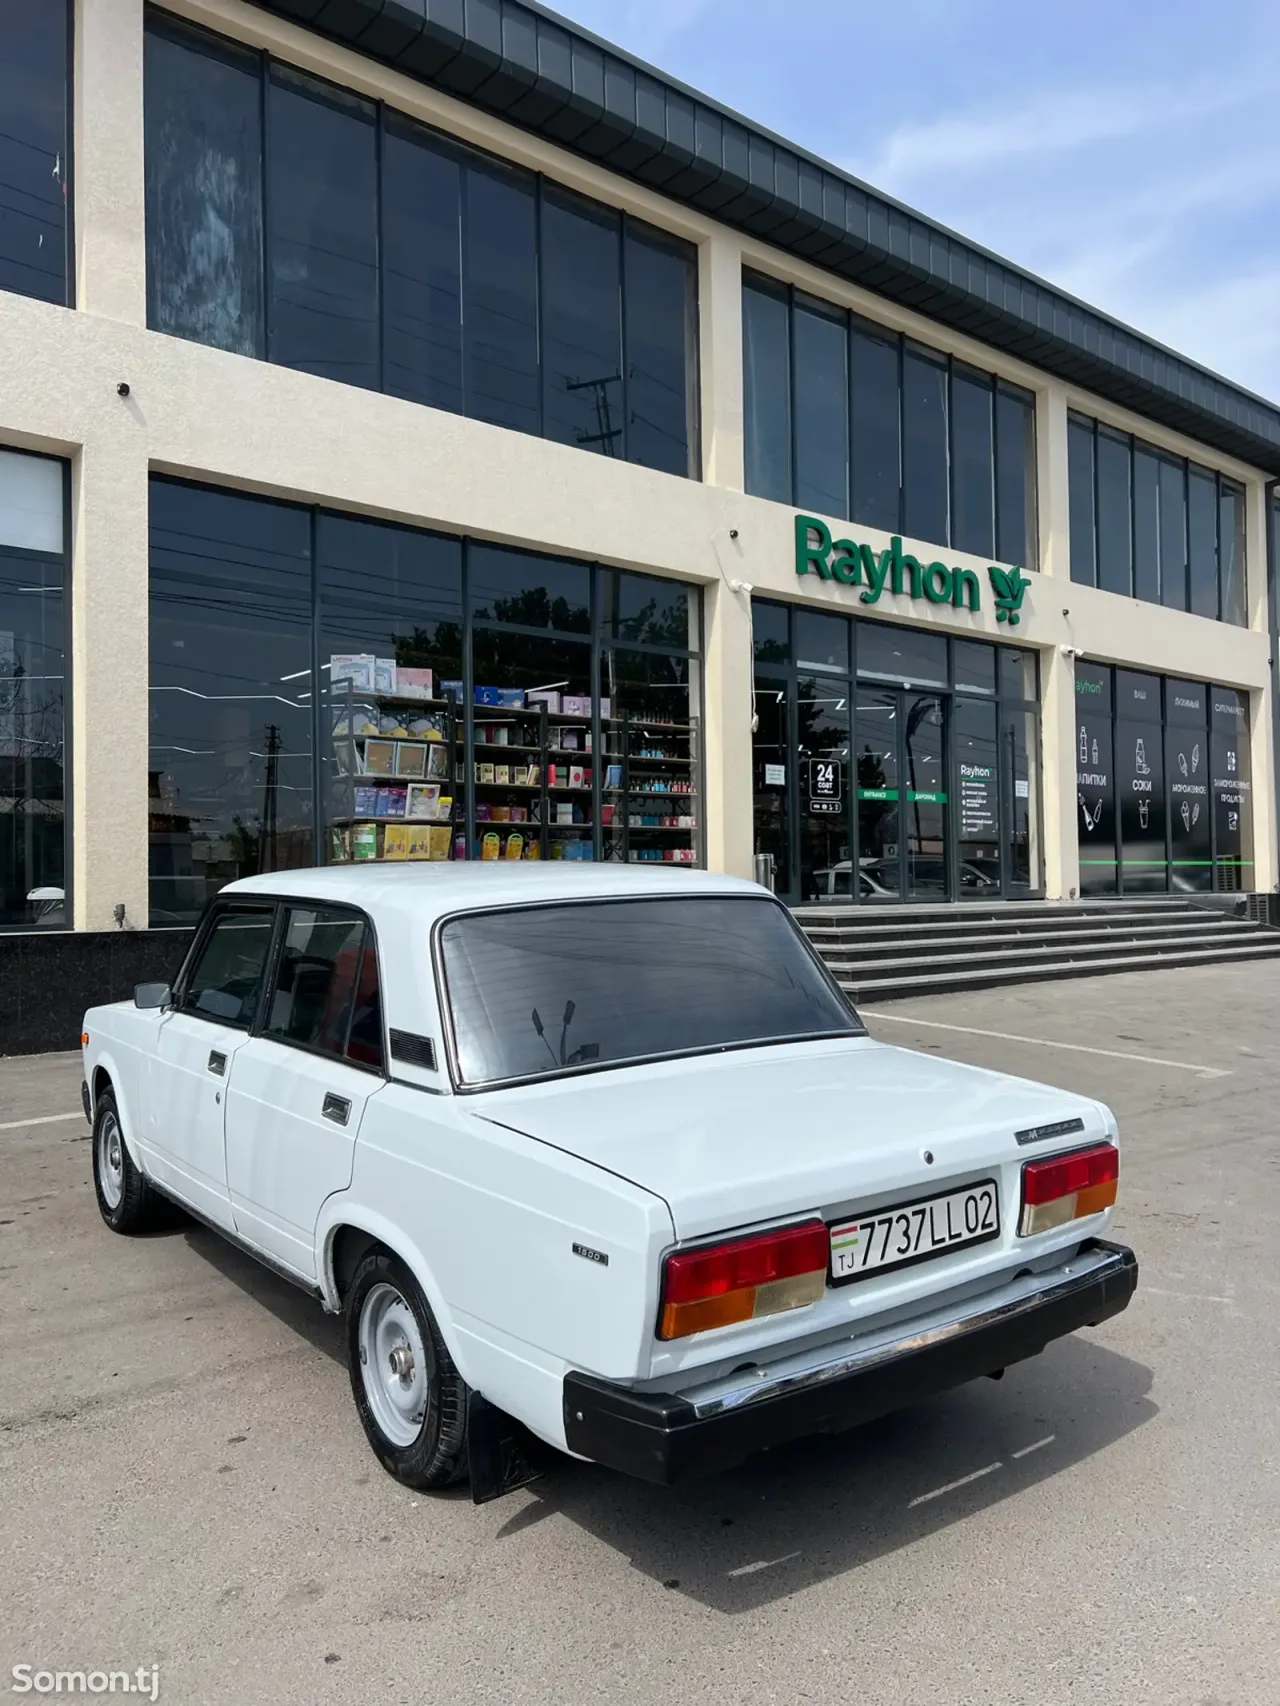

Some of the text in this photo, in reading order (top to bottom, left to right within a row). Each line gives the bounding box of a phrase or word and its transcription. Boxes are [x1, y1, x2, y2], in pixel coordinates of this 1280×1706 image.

[795, 514, 980, 611] Rayhon
[1076, 679, 1101, 694] ayhon
[1134, 689, 1147, 700] ВАШ
[817, 764, 834, 782] 24
[960, 765, 990, 778] Rayhon
[1077, 772, 1107, 787] АПИТКИ
[1132, 779, 1152, 792] СОКИ
[863, 790, 887, 799] ENTRANCE
[1220, 793, 1245, 804] ПРОДУКТЫ
[859, 1190, 994, 1267] 7737LL02
[838, 1252, 855, 1271] TJ
